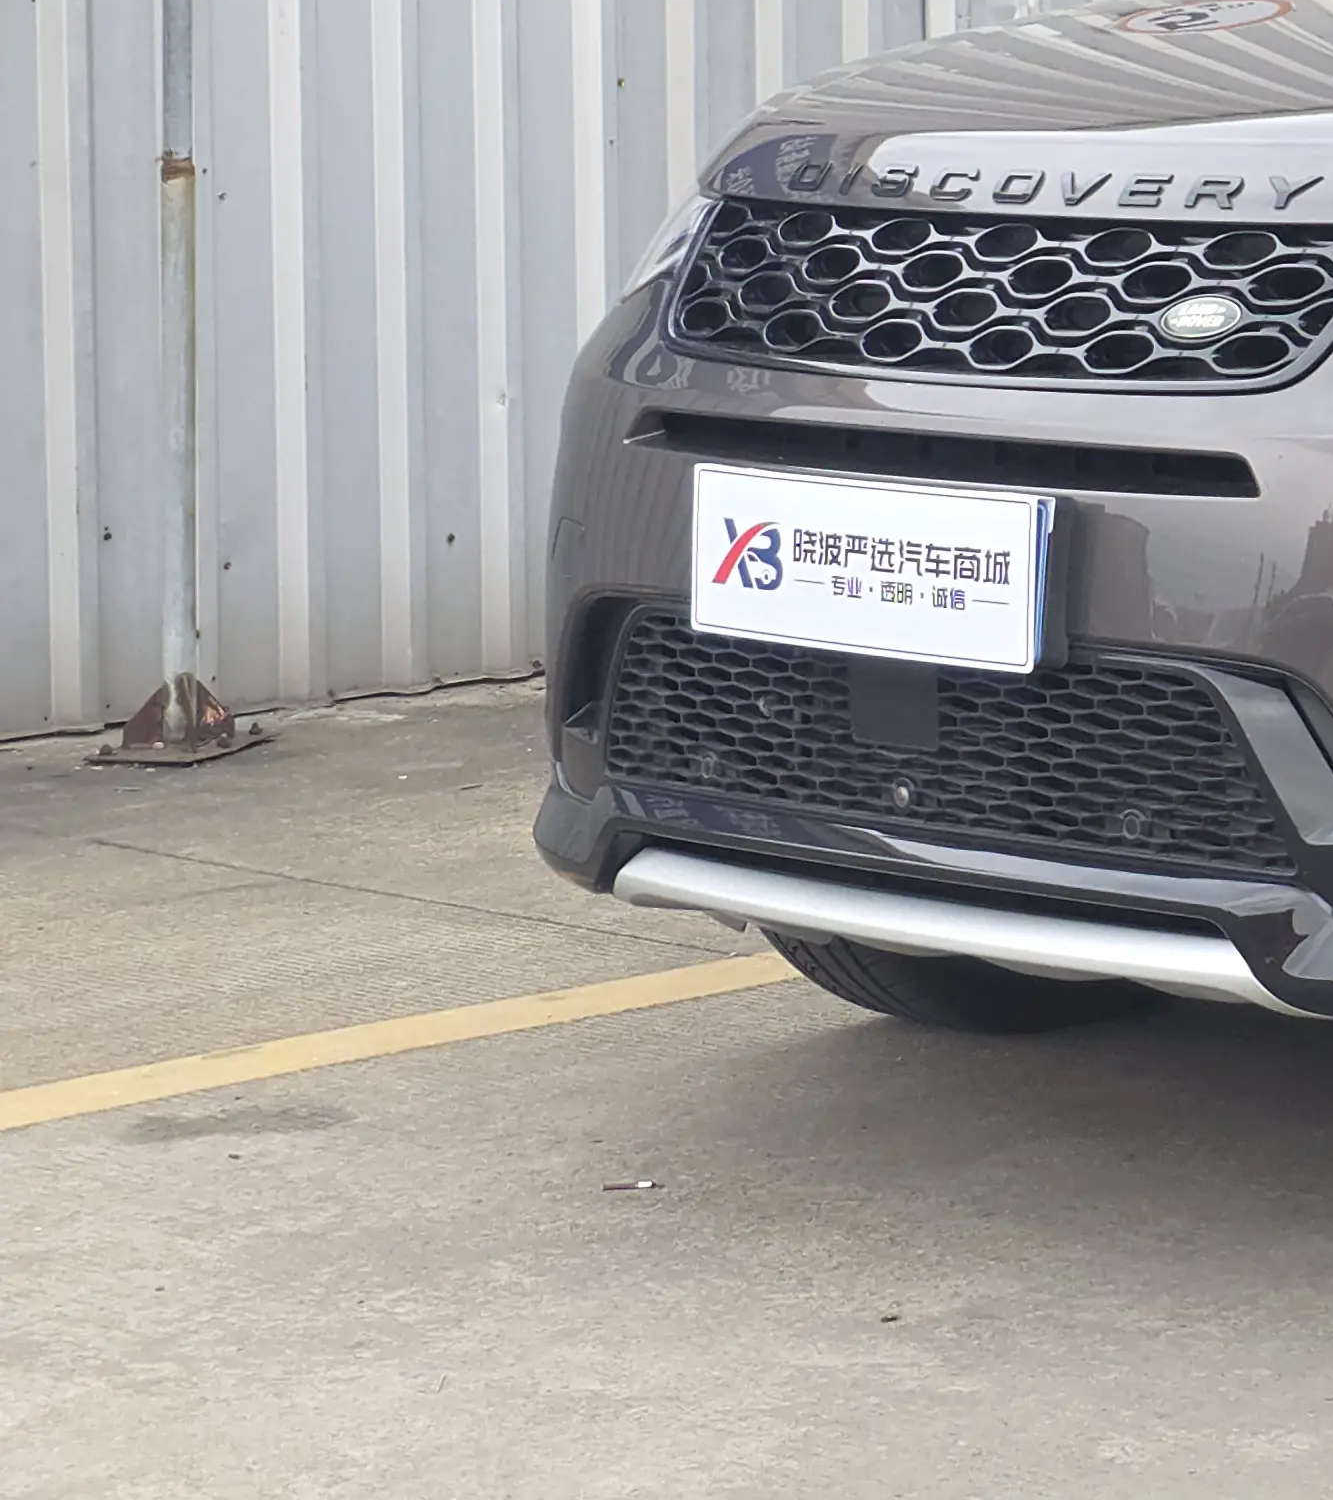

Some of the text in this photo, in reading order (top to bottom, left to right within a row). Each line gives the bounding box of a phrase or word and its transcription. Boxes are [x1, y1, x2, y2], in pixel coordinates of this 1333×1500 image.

[788, 162, 1325, 210] DISCOVERY
[792, 528, 1011, 586] 晓波严选汽车商城
